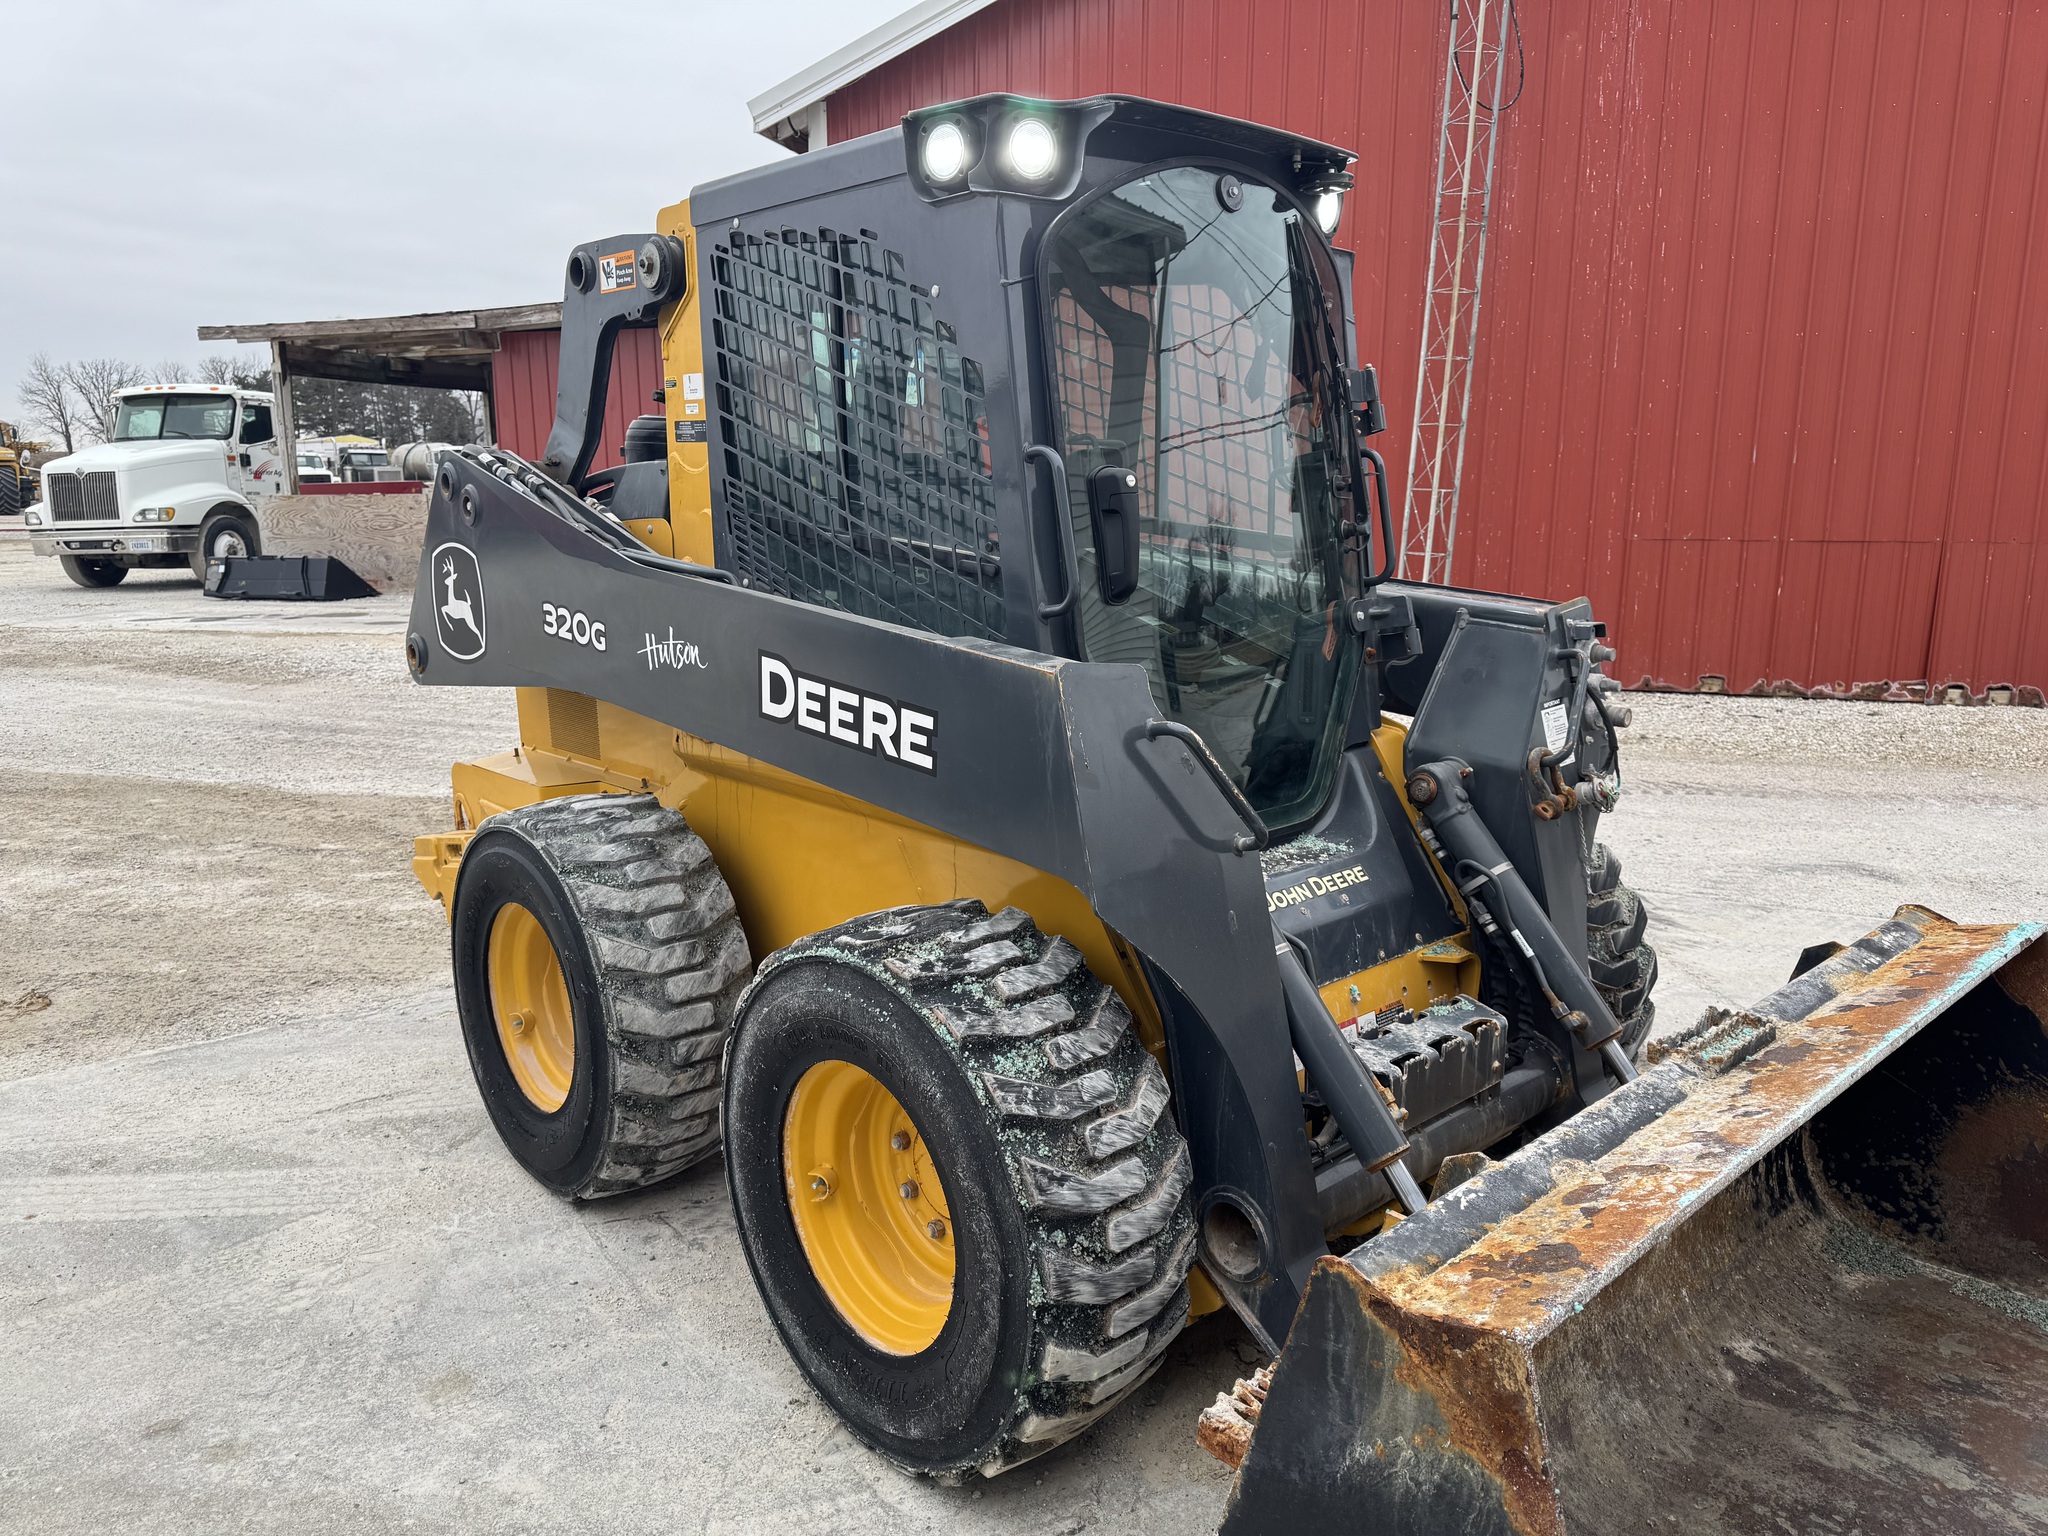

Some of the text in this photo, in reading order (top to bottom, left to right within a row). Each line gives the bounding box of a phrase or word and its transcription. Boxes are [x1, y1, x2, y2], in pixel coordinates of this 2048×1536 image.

[542, 603, 607, 651] 320G
[637, 626, 709, 671] Hutson
[760, 655, 935, 770] DEERE
[1265, 865, 1370, 913] JOHN DEERE
